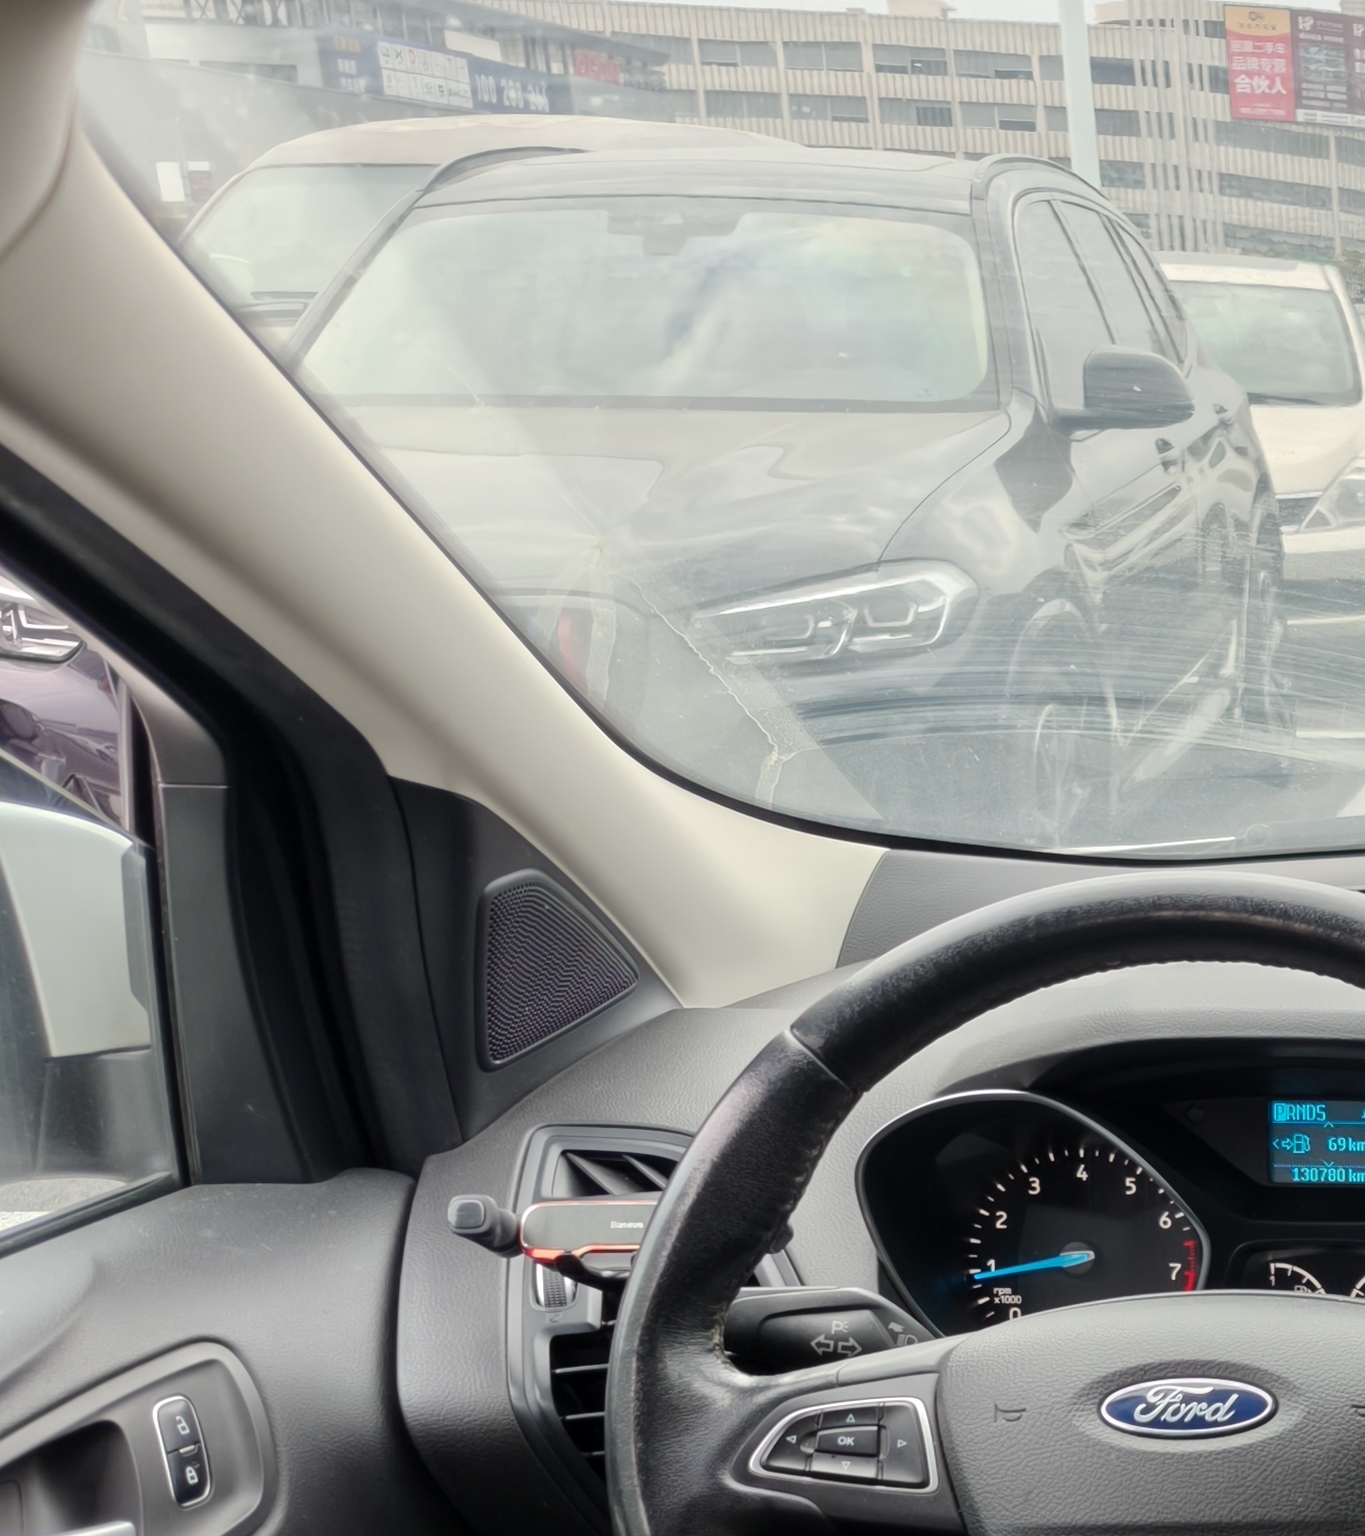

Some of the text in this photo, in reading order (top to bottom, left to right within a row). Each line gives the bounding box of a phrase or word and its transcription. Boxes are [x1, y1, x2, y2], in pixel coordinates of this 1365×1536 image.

[1234, 74, 1287, 95] 合伙人
[1273, 1103, 1326, 1121] PRNDS
[1328, 1137, 1346, 1151] 69
[1076, 1164, 1088, 1181] 4
[1292, 1168, 1346, 1182] 130780
[1028, 1177, 1041, 1195] 3
[1125, 1177, 1136, 1195] 5
[995, 1211, 1007, 1229] 2
[1158, 1211, 1172, 1228] 6
[1168, 1263, 1182, 1280] 7
[1269, 1275, 1276, 1287] 1
[993, 1287, 1012, 1296] rpm
[994, 1295, 1022, 1304] x1000
[1133, 1385, 1239, 1423] Ford
[837, 1435, 855, 1446] OK
